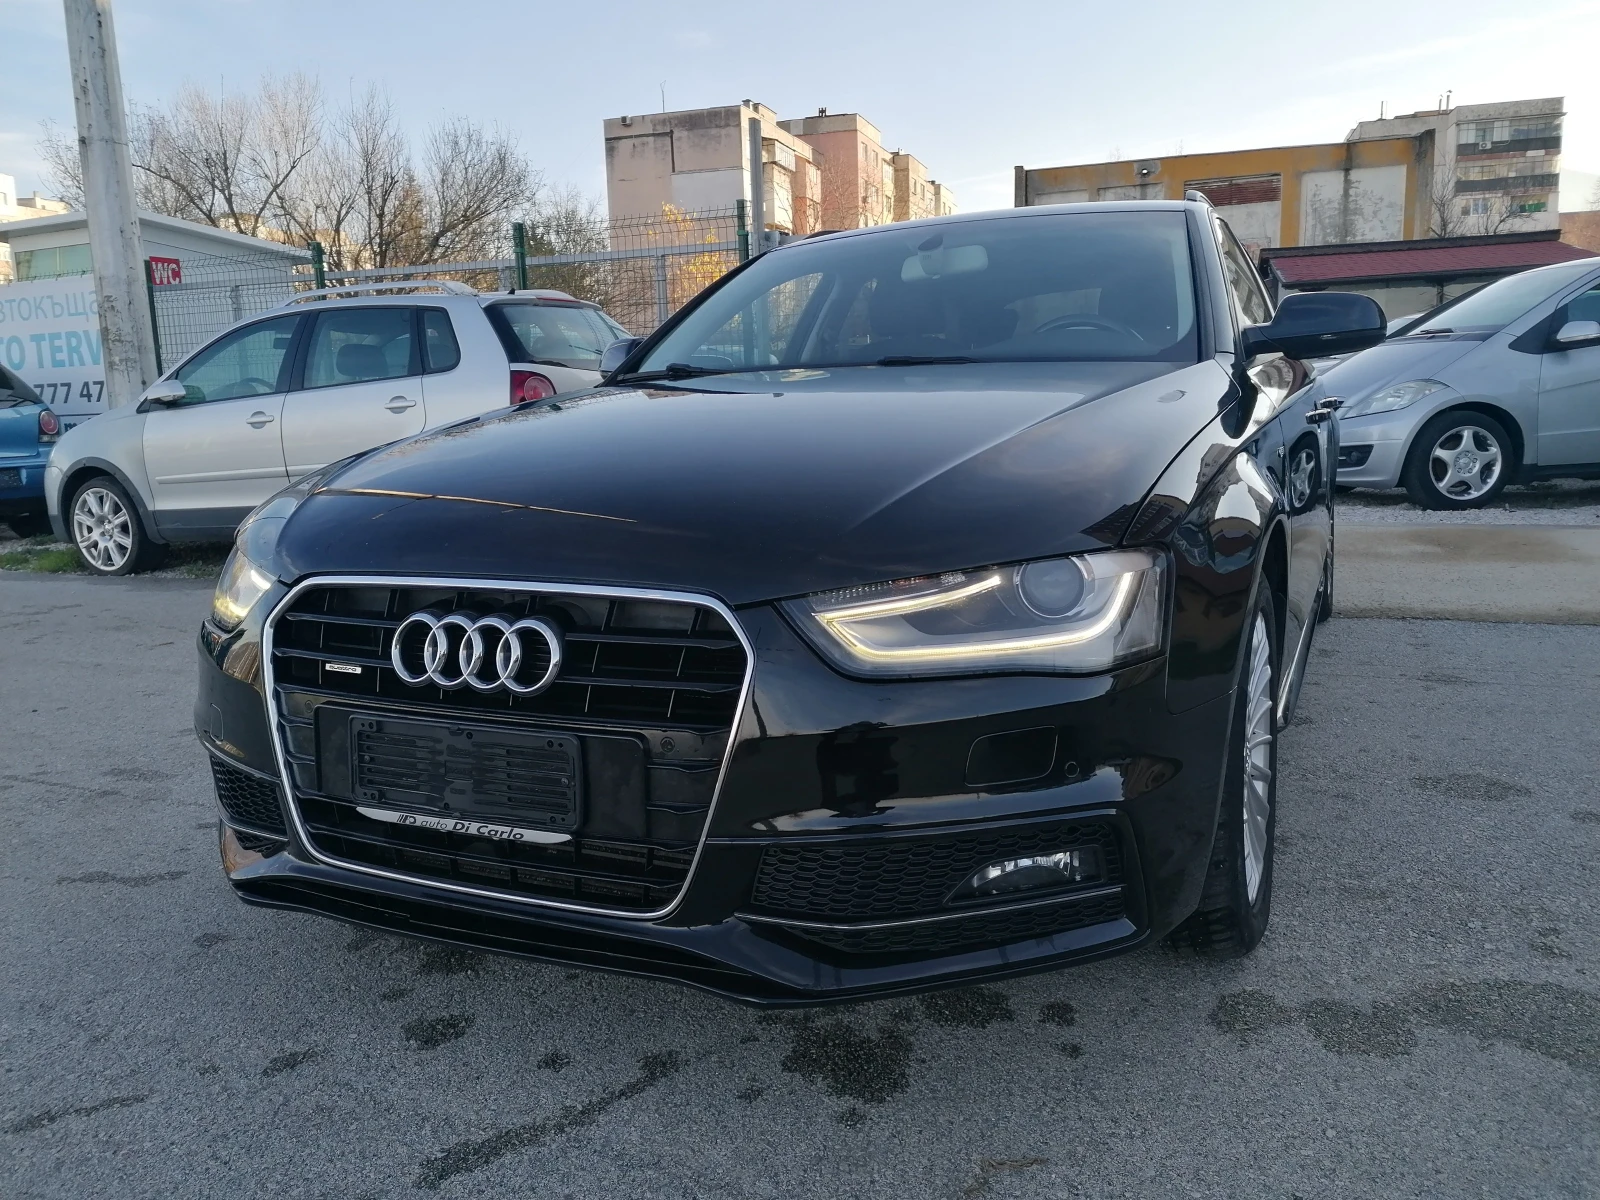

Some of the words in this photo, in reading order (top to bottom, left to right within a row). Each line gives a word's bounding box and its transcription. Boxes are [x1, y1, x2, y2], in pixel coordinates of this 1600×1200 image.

[151, 261, 180, 284] WC
[0, 335, 26, 371] O
[33, 382, 72, 405] 777
[79, 380, 105, 403] 47
[420, 819, 448, 830] auto
[452, 821, 472, 833] Di
[476, 825, 524, 840] Carlo
